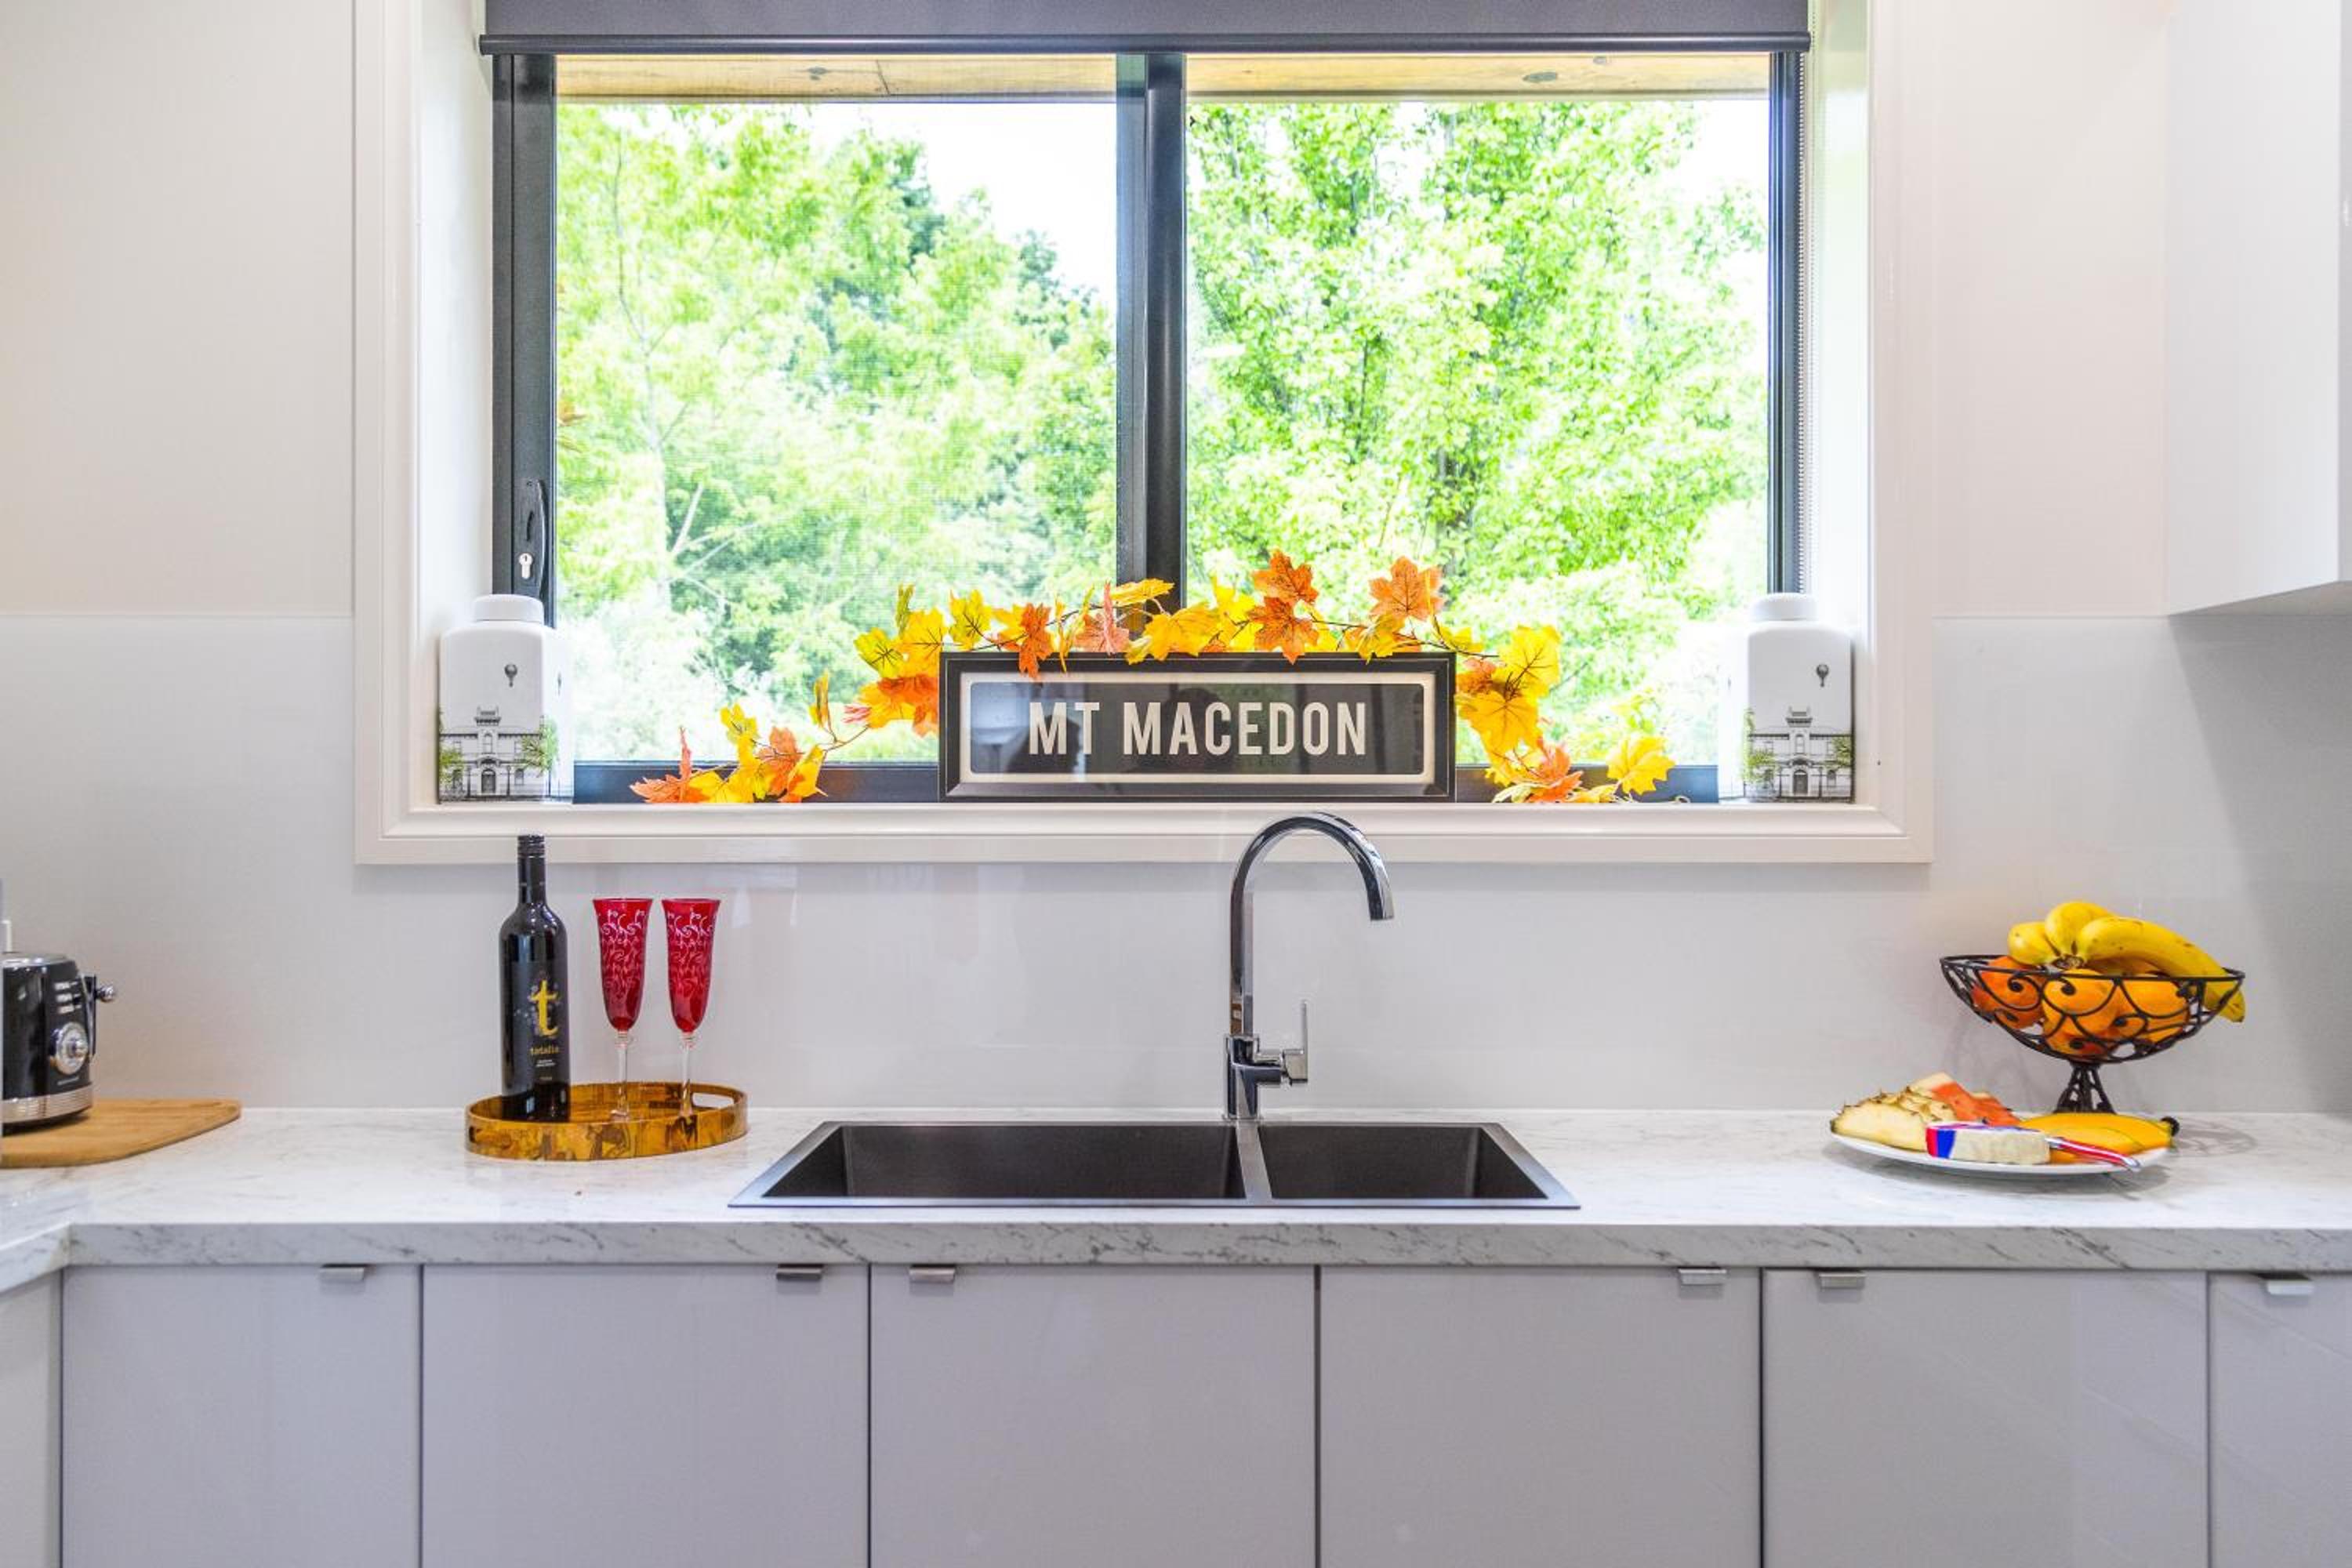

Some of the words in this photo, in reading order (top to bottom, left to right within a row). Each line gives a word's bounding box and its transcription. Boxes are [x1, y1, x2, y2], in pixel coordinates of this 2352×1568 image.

[1029, 702, 1100, 755] MT
[1123, 702, 1367, 755] MACEDON
[528, 979, 559, 1036] t
